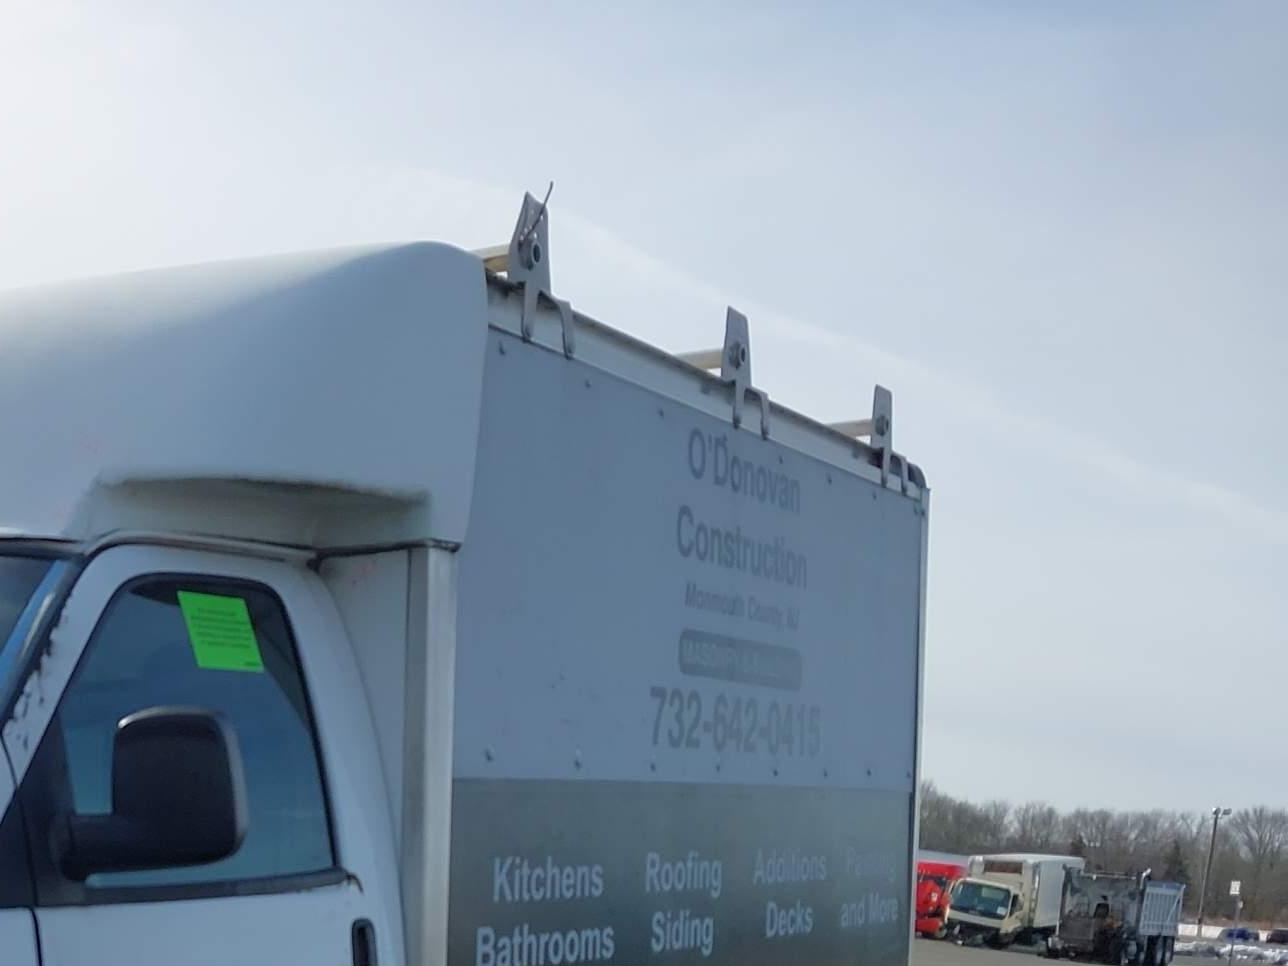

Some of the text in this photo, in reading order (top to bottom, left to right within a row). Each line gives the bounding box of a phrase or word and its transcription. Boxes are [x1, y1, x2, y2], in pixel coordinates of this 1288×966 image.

[688, 428, 800, 515] O'Donovan
[676, 505, 807, 589] Construction
[493, 857, 604, 902] Kitchens
[645, 852, 722, 898] Roofing
[753, 848, 826, 885] Additions
[765, 898, 814, 938] Decks
[840, 890, 899, 928] and More
[651, 911, 713, 957] Siding
